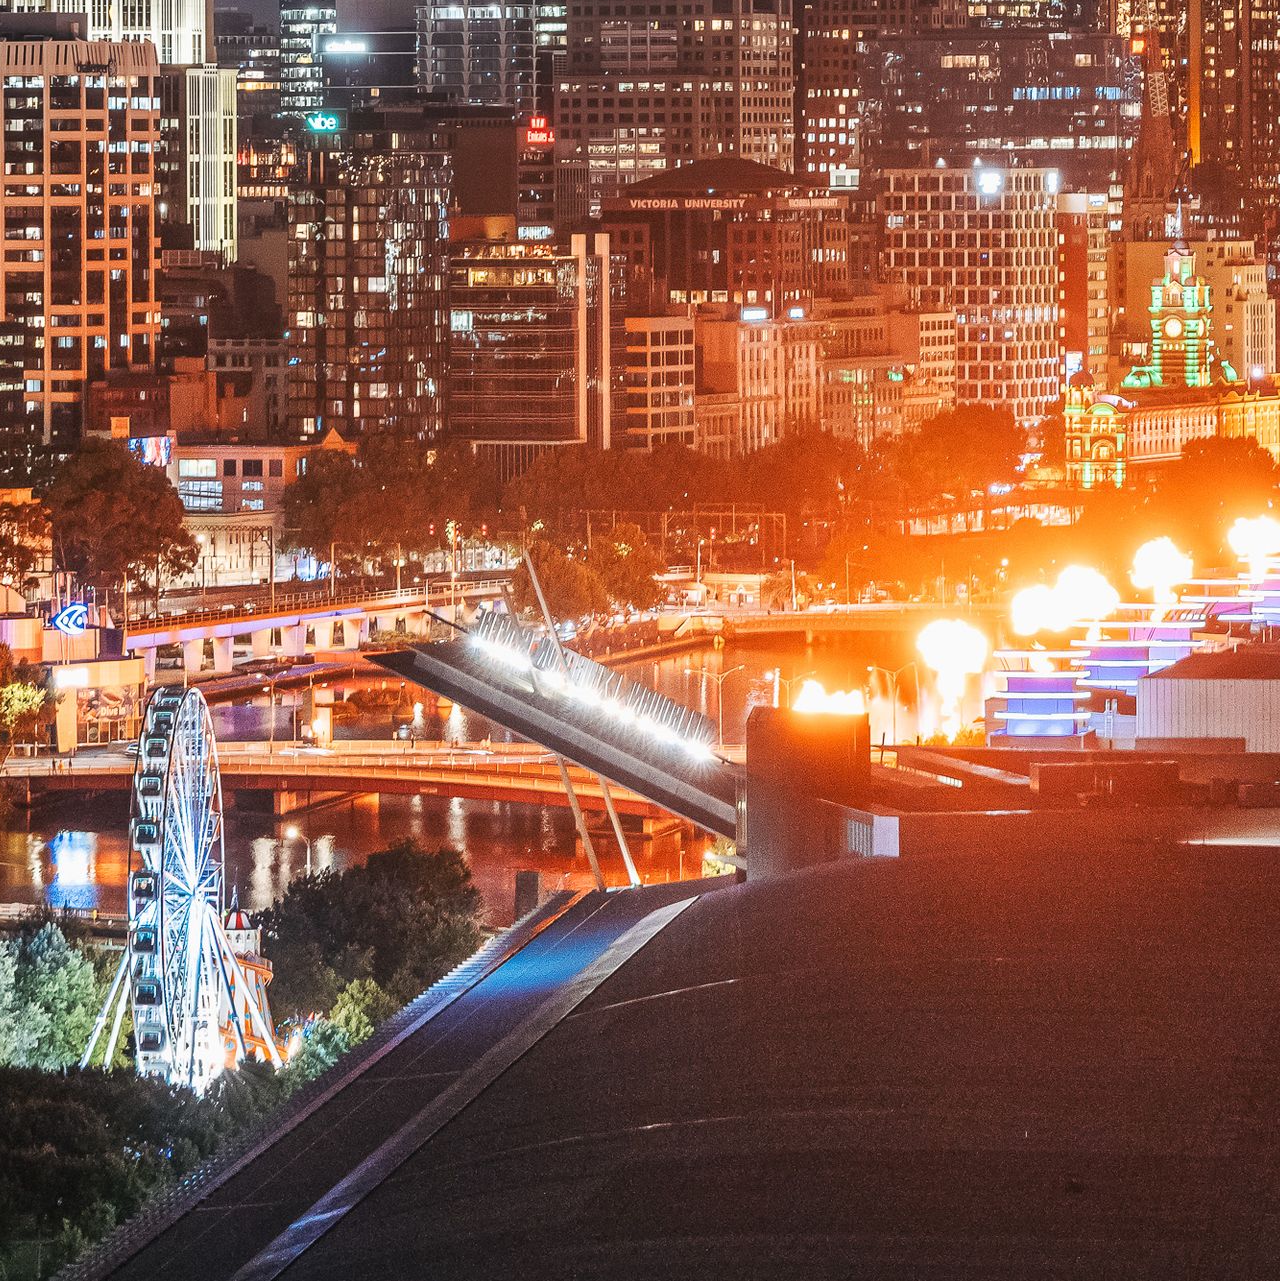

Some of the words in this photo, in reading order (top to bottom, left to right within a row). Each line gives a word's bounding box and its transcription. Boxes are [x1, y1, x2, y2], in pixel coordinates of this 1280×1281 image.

[307, 112, 337, 130] vibe
[630, 199, 679, 209] VICTORIA
[684, 199, 746, 209] UNIVERSITY
